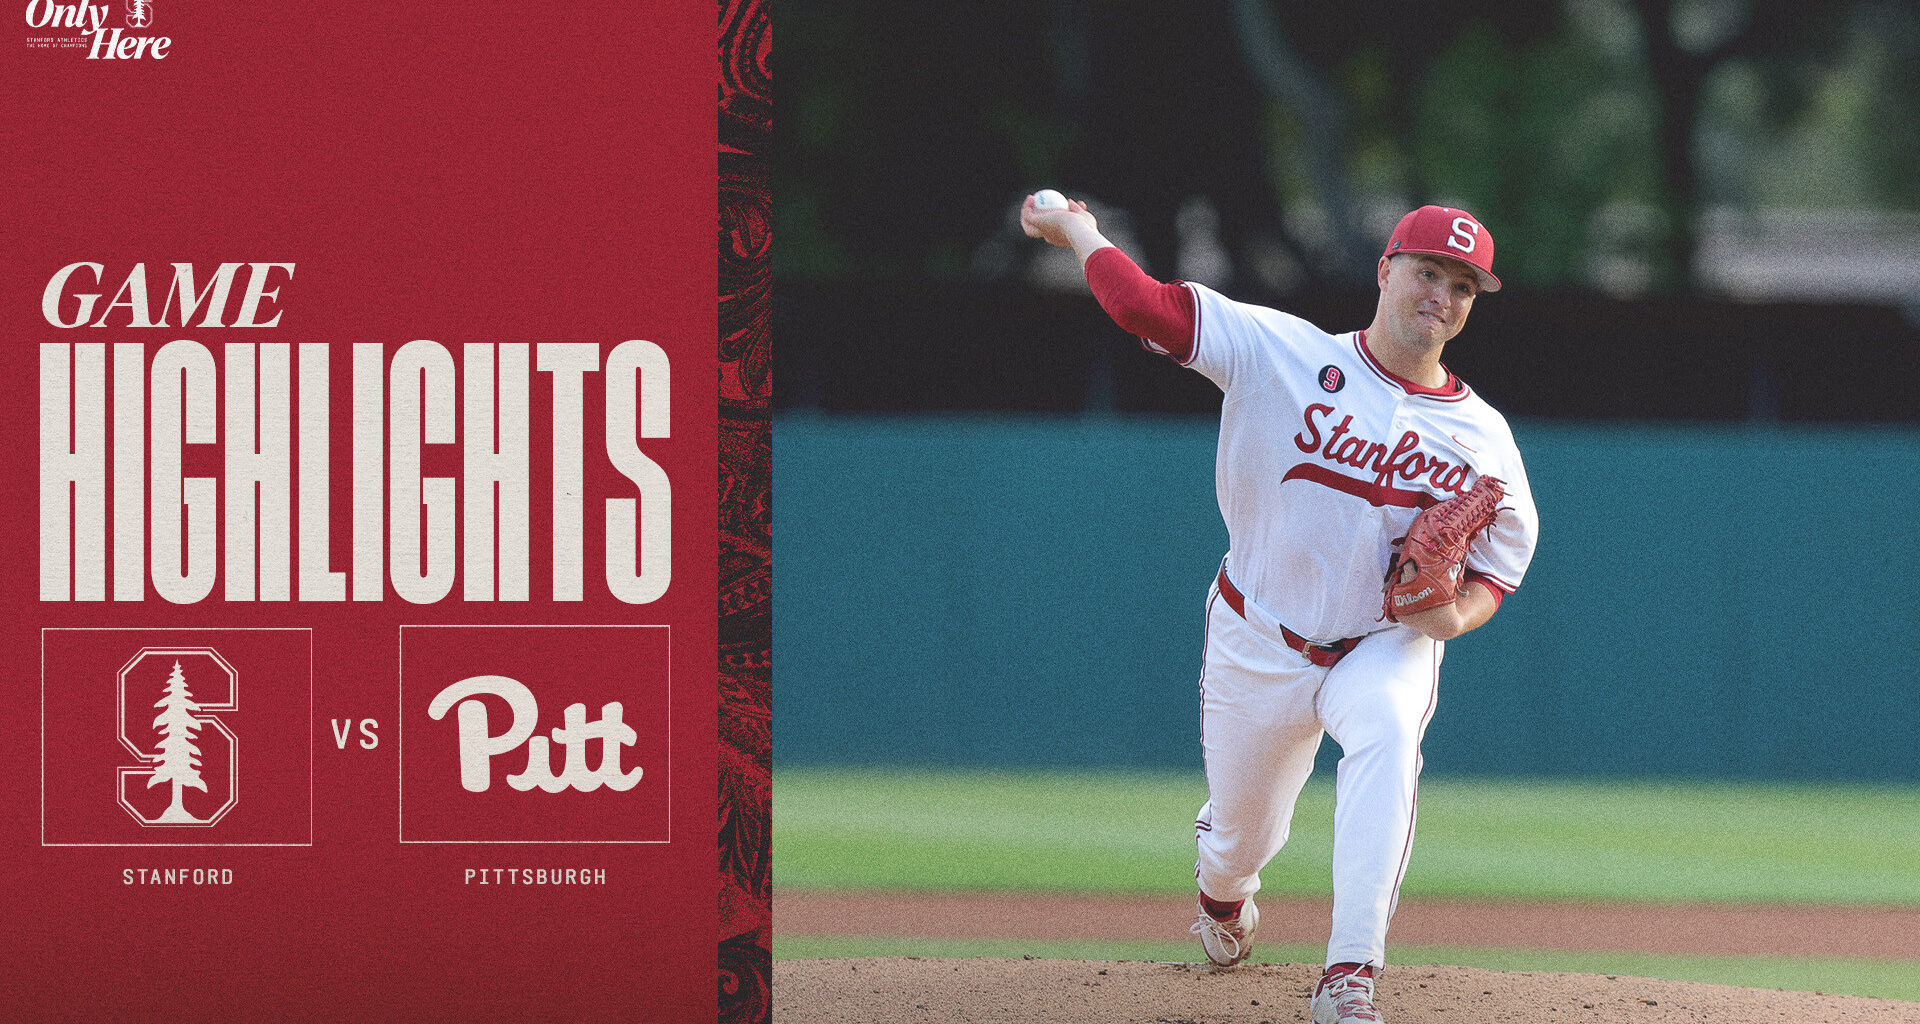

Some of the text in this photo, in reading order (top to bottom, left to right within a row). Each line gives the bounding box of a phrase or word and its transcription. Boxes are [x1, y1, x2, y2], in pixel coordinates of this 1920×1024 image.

[1447, 217, 1479, 254] S
[1323, 366, 1341, 391] 9
[1294, 403, 1473, 496] Stanford
[1394, 586, 1433, 607] Wilson
